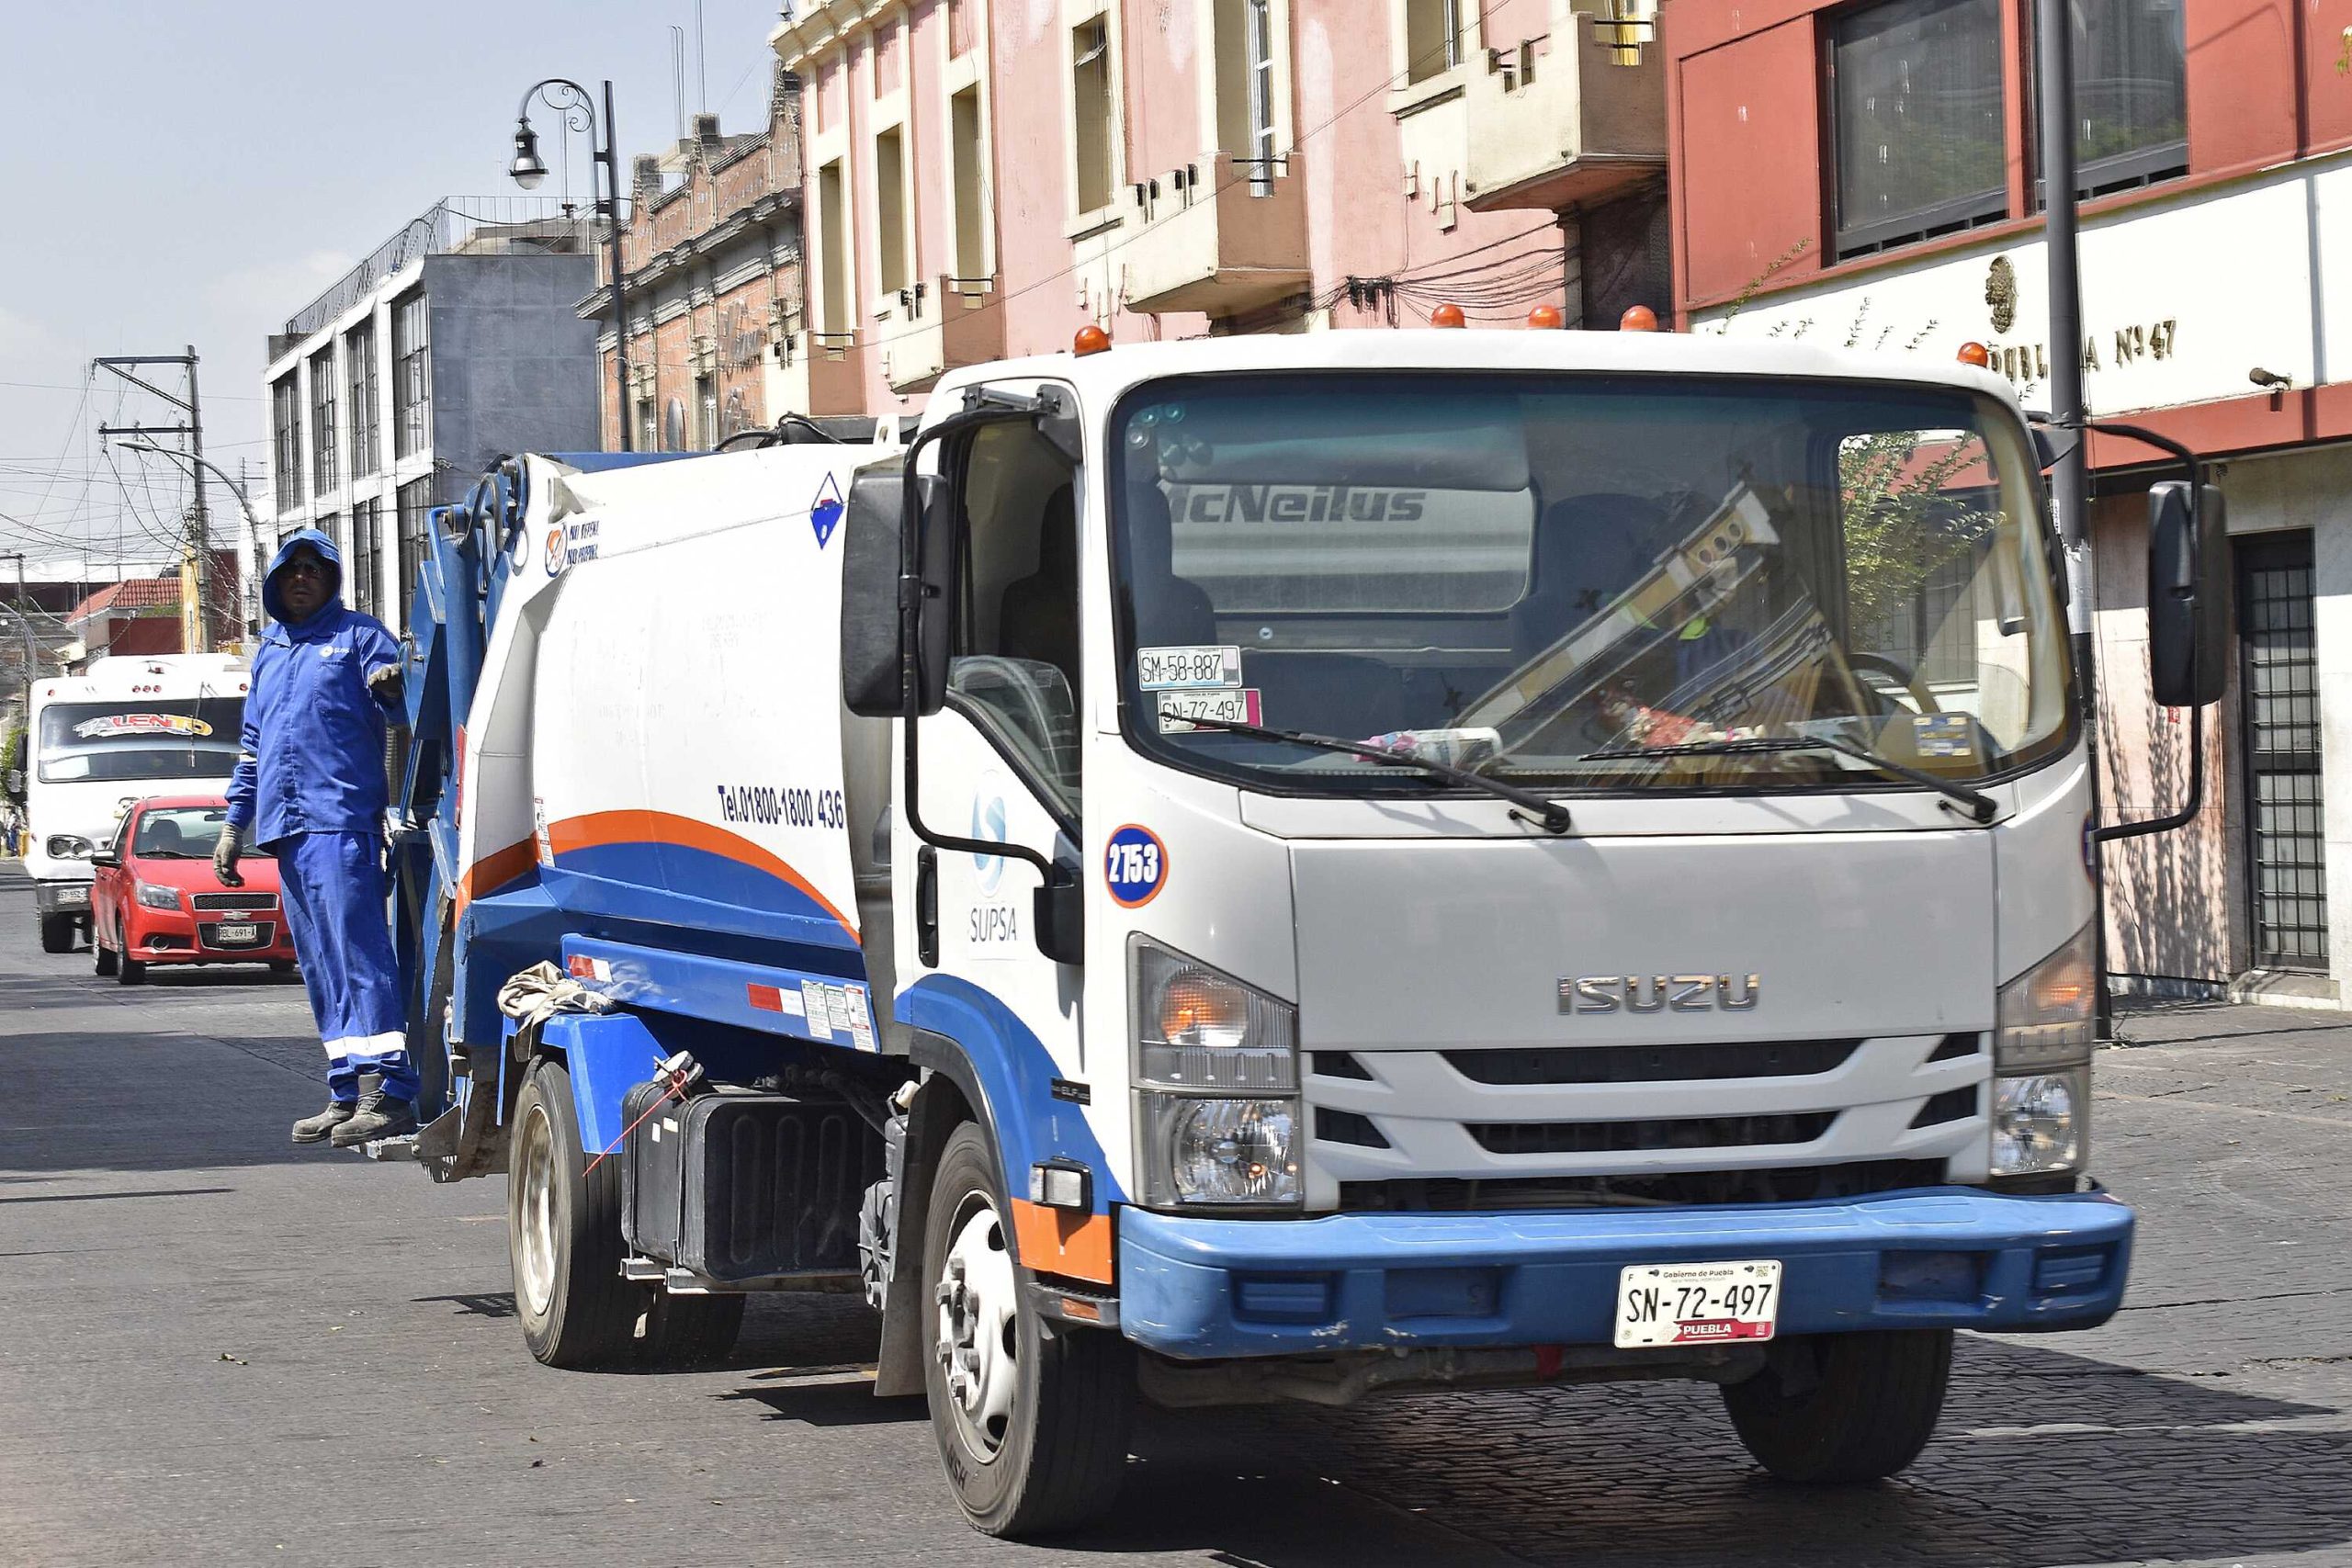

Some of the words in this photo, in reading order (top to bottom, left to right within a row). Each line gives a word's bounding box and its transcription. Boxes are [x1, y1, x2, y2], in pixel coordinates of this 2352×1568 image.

[1141, 654, 1221, 682] SM-58-887
[73, 714, 213, 738] TALENTO
[818, 789, 844, 829] 436
[970, 906, 1017, 942] SUPSA
[1558, 974, 1758, 1015] ISUZU
[1663, 1270, 1697, 1279] Gobierno
[1698, 1269, 1708, 1278] de
[1709, 1269, 1735, 1277] Puebla
[1626, 1283, 1773, 1323] SN-72-497
[1683, 1323, 1732, 1336] PUEBLA
